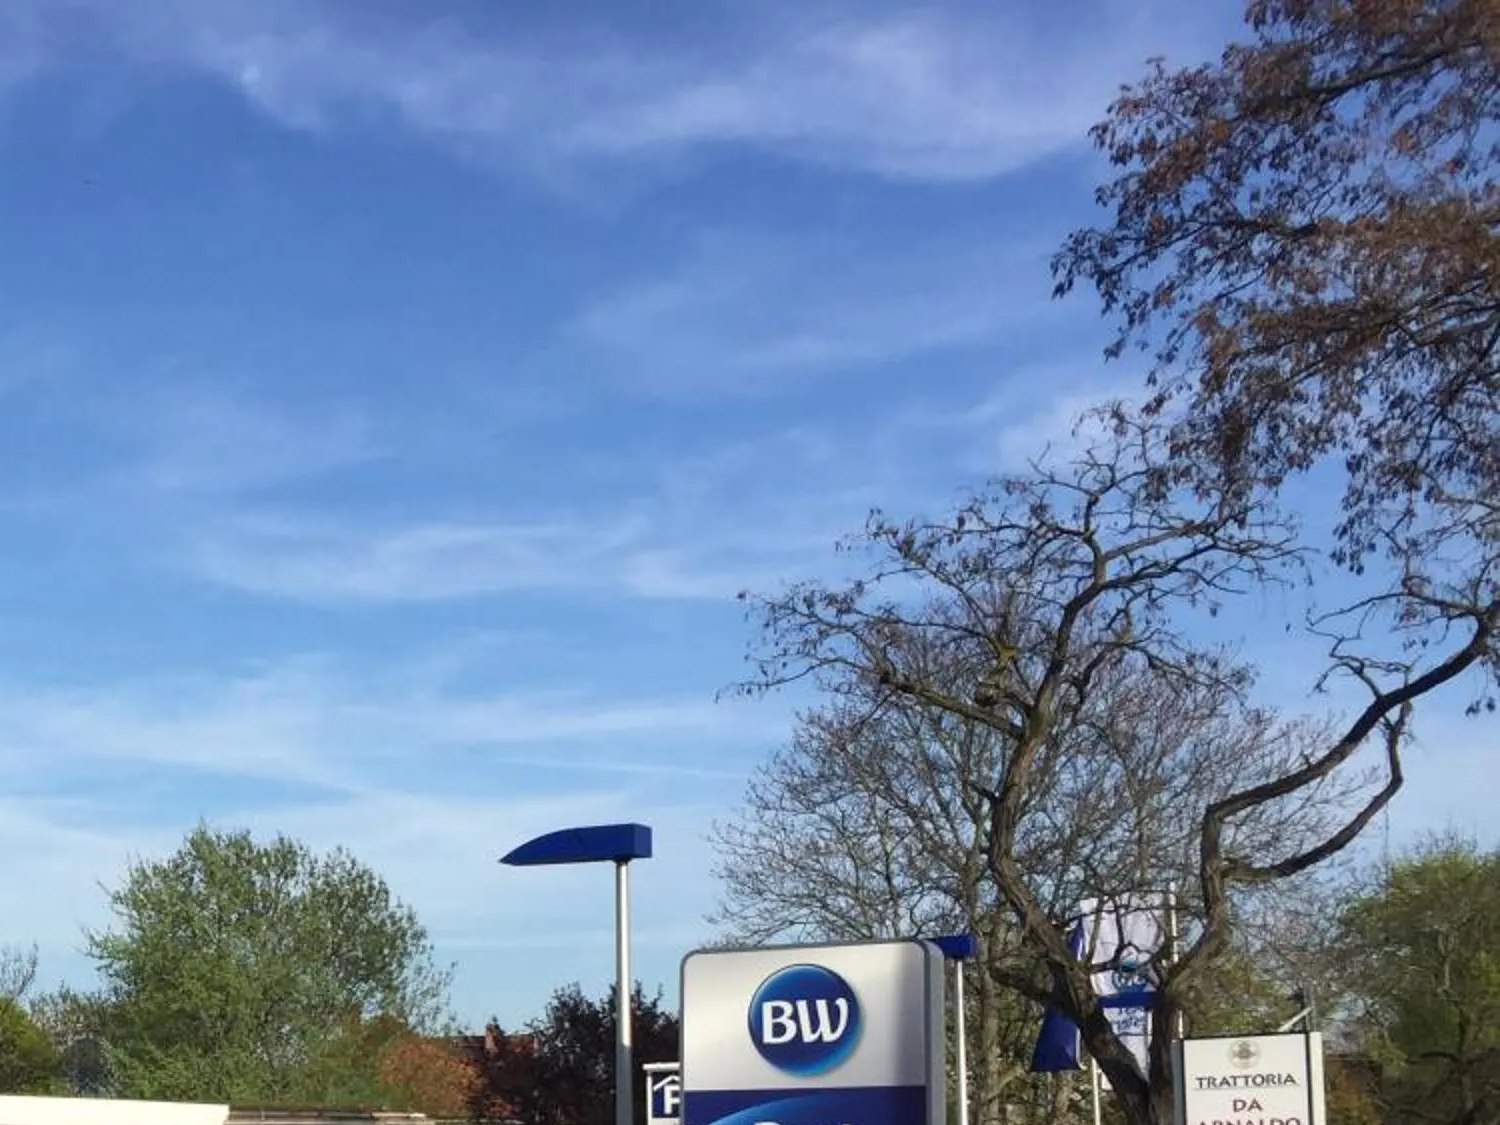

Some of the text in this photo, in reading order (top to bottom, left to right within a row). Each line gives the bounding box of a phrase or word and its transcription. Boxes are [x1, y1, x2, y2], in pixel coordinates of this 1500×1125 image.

[761, 999, 848, 1044] BW
[1196, 1073, 1296, 1089] TRATTORIA
[1232, 1099, 1263, 1113] DA
